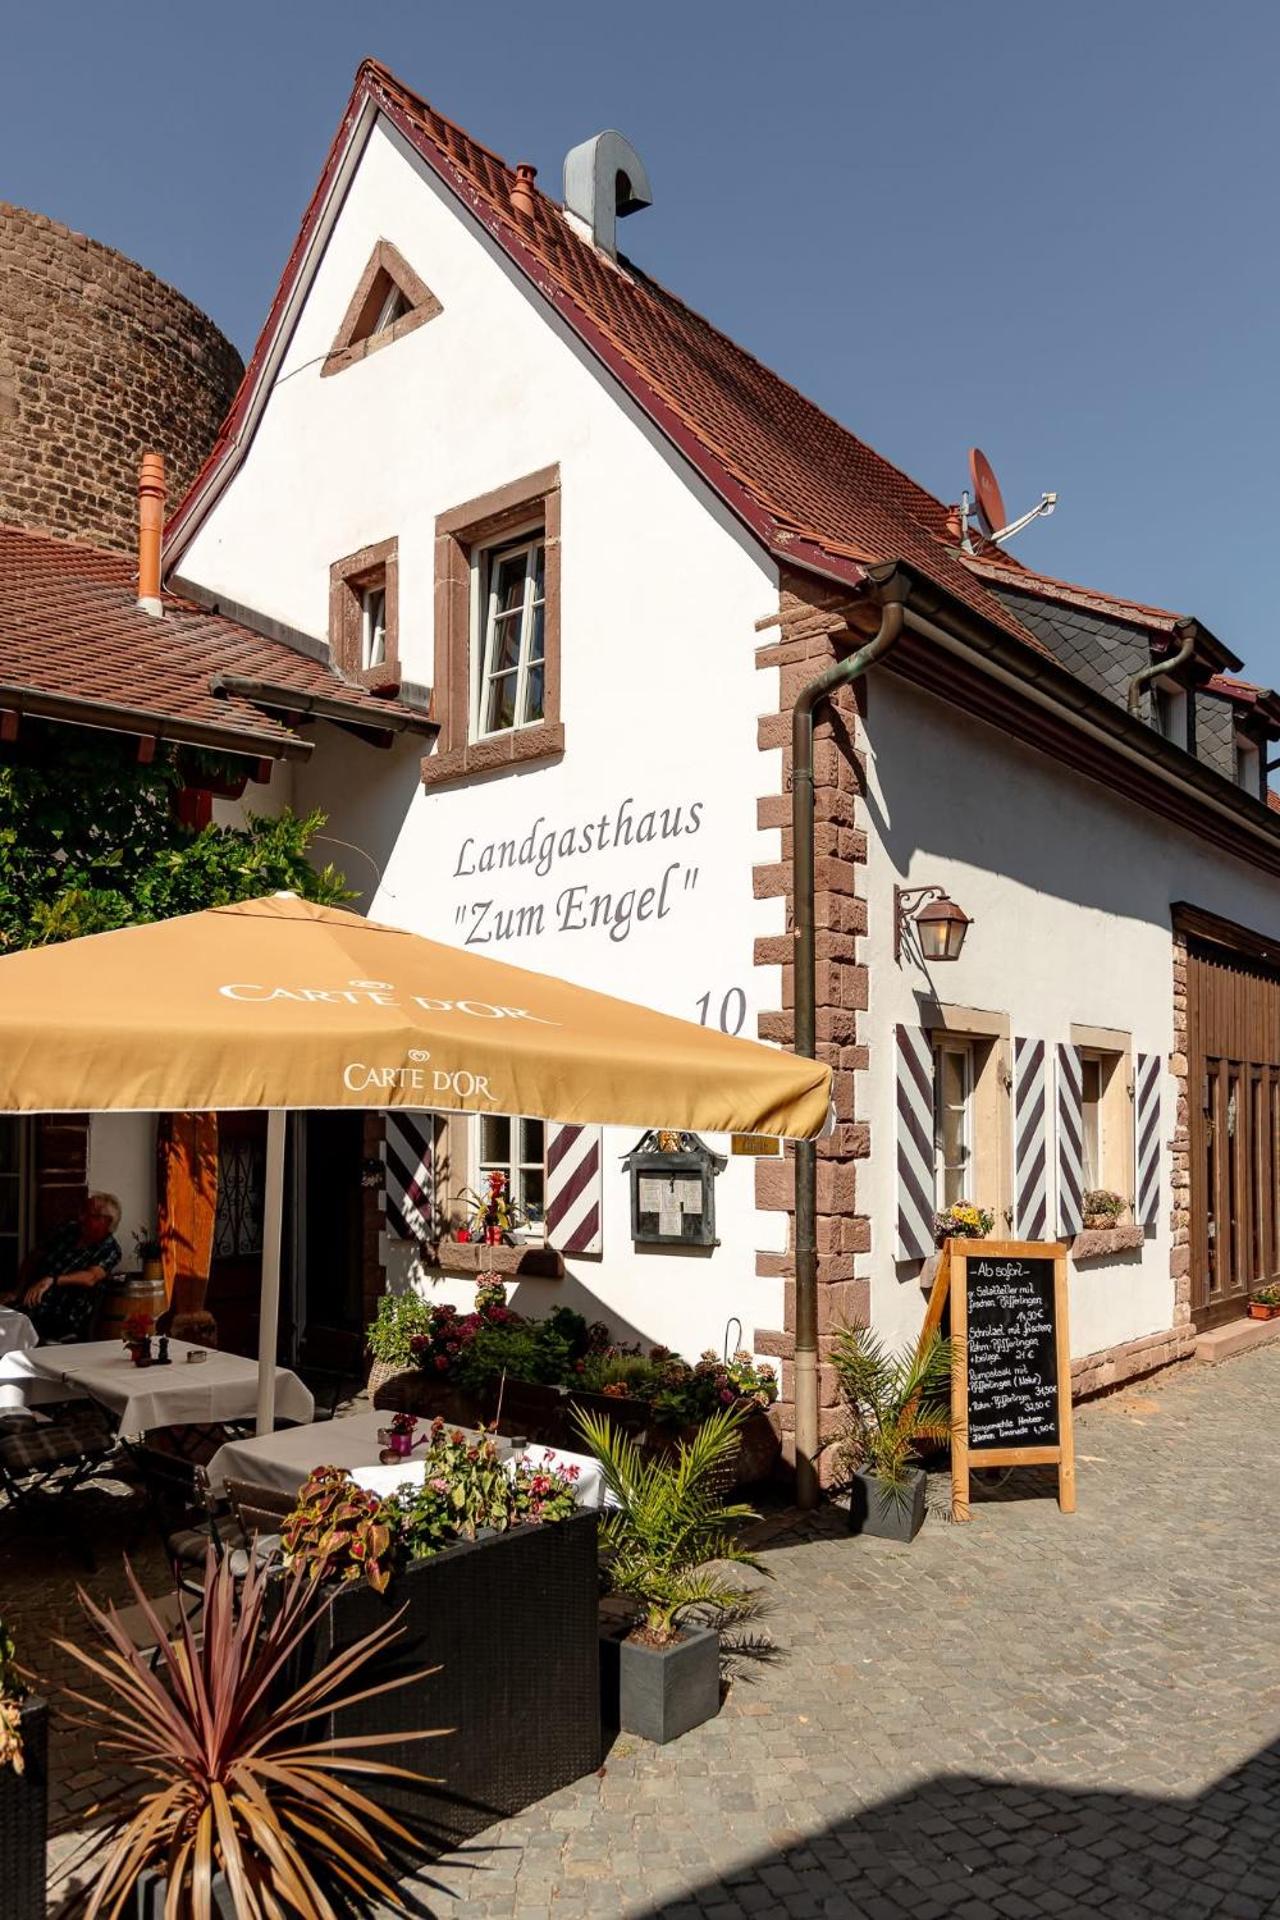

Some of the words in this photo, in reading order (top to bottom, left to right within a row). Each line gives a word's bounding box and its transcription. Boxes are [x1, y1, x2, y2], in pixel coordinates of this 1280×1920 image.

[453, 798, 703, 877] Landgasthaus
[455, 900, 544, 945] "Zum
[556, 863, 699, 942] Engel"
[219, 984, 401, 1006] CARTE
[411, 996, 563, 1026] D'OR
[696, 987, 746, 1036] 10
[343, 1063, 424, 1091] CARTE
[434, 1071, 499, 1101] D'OR
